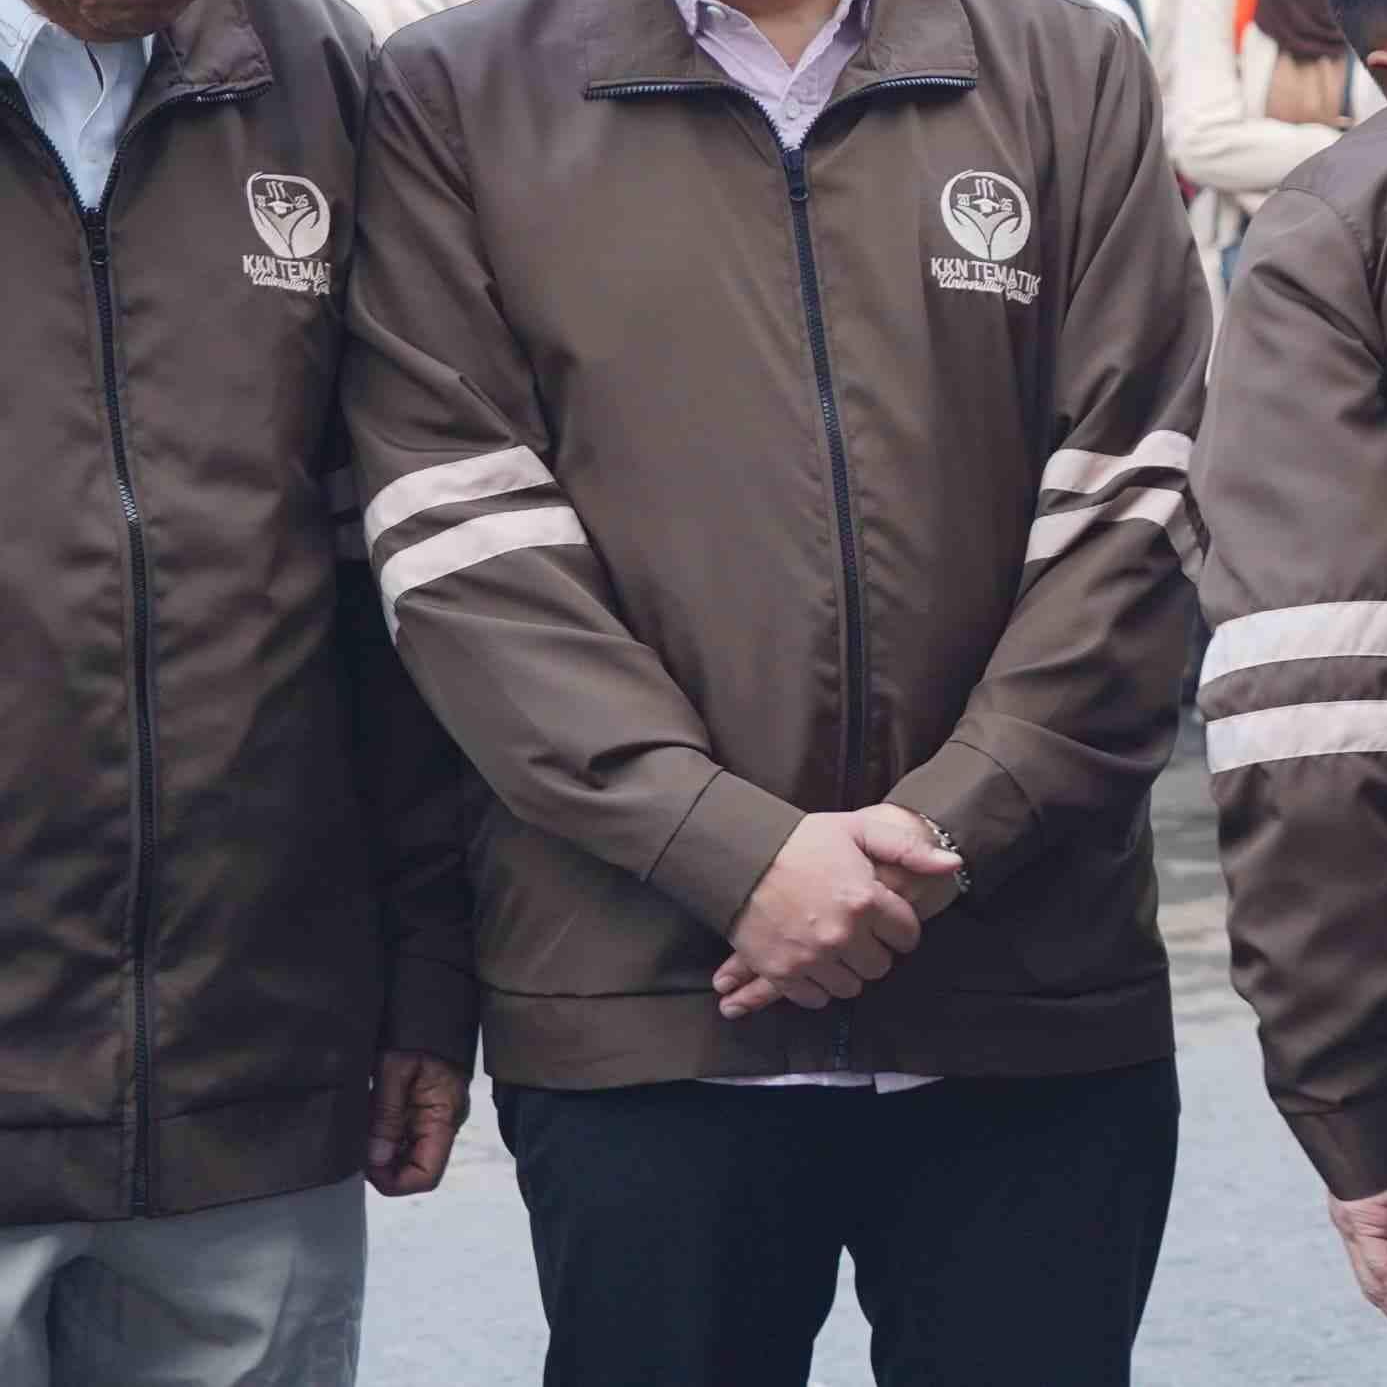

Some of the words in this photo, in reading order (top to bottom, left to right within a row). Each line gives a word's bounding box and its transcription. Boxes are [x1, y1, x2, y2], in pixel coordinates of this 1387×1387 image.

[242, 254, 277, 276] KKN
[930, 257, 969, 279] KKN
[970, 259, 1041, 297] TEMATIK
